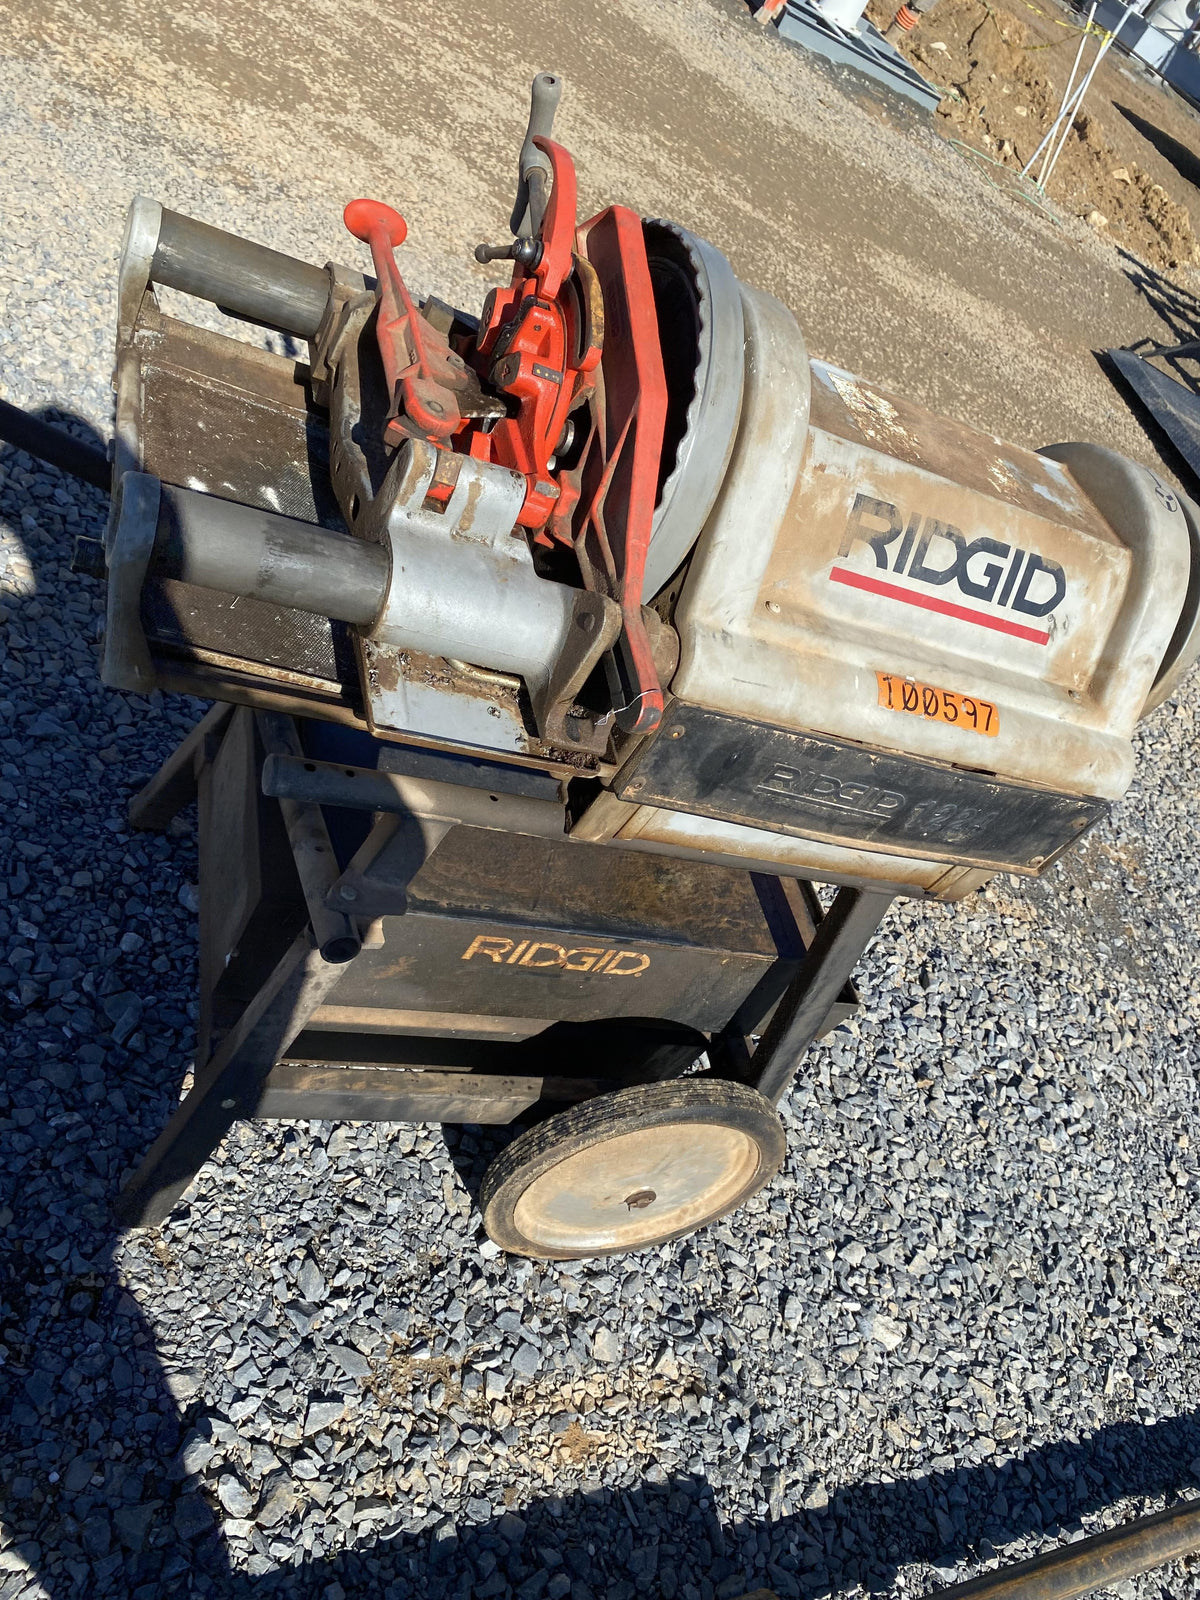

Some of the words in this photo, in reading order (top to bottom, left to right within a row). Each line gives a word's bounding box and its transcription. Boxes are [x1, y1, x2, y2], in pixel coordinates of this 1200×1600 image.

[838, 493, 1066, 617] RIDGID
[882, 675, 993, 731] 100597
[757, 763, 906, 810] RIDGID
[461, 935, 651, 976] RIDGID
